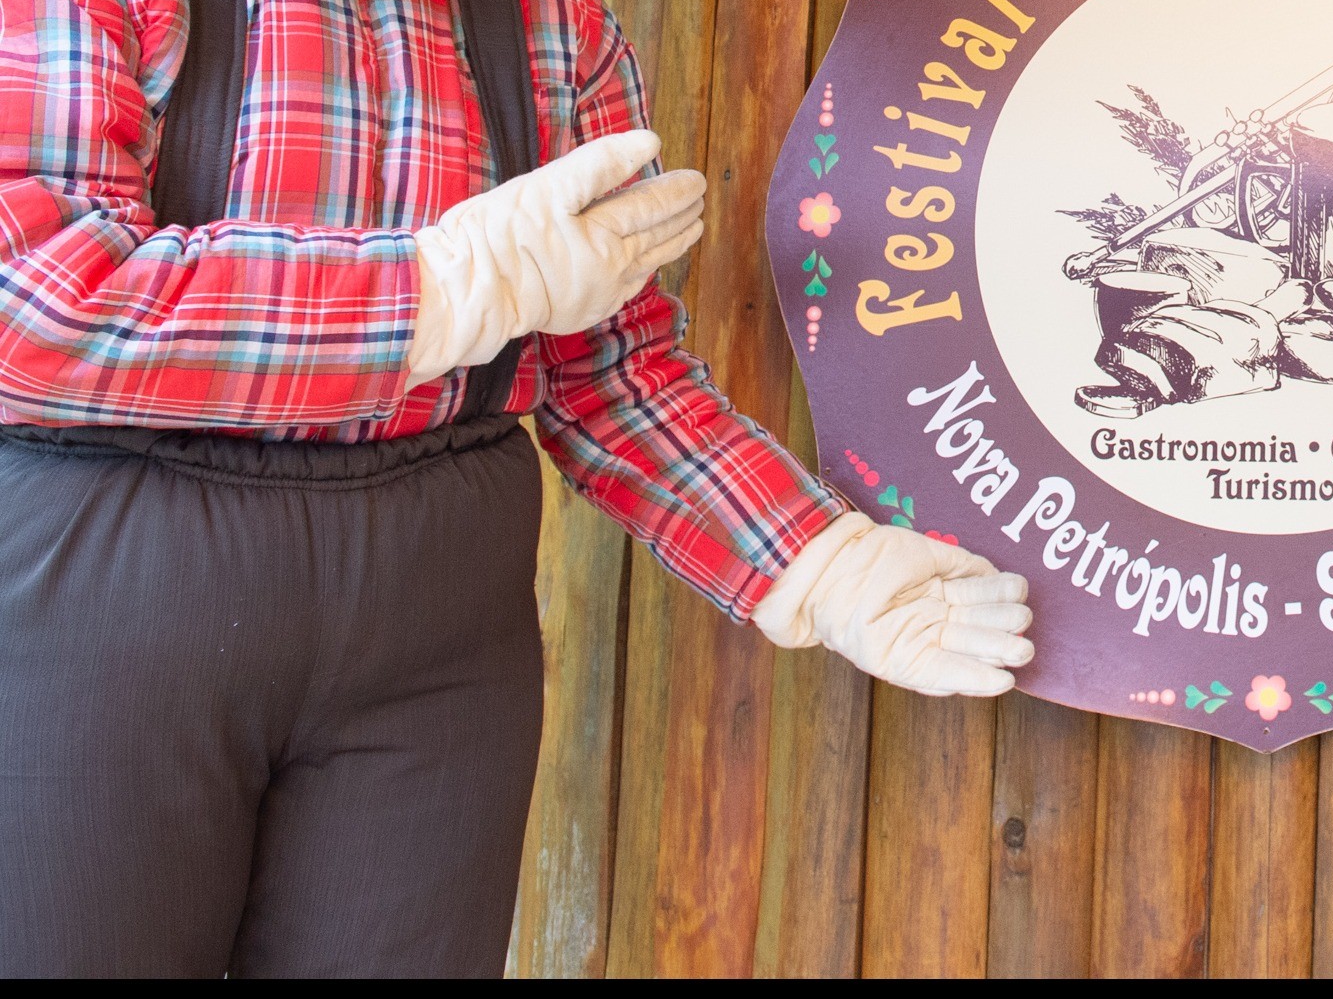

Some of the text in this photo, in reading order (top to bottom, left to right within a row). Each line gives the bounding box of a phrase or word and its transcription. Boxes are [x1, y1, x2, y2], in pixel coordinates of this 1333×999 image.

[906, 360, 1020, 517] Nova
[1000, 476, 1269, 639] Petrópolis
[1090, 427, 1299, 463] Gastronomia
